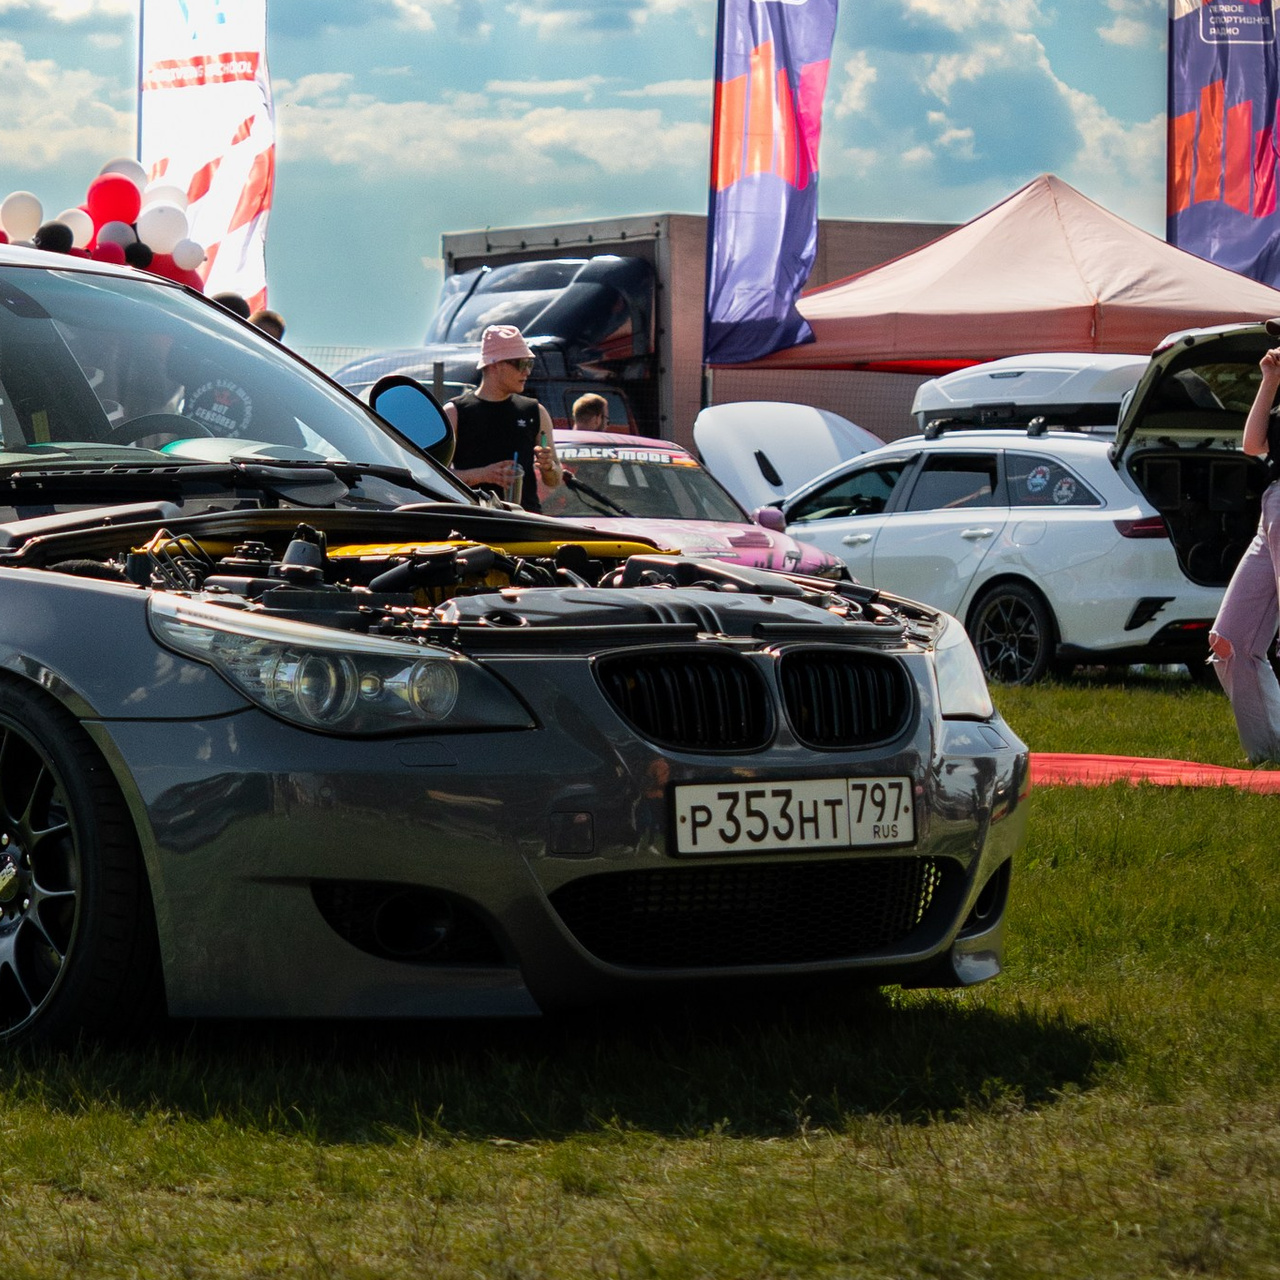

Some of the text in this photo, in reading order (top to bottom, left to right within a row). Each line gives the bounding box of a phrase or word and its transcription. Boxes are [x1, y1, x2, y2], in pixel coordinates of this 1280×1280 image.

[1209, 4, 1245, 13] ПЕРВОЕ
[1209, 16, 1271, 25] СПОРТИВНОЕ
[1209, 27, 1240, 36] РАДИО
[851, 782, 904, 824] 797
[873, 824, 899, 840] RUS
